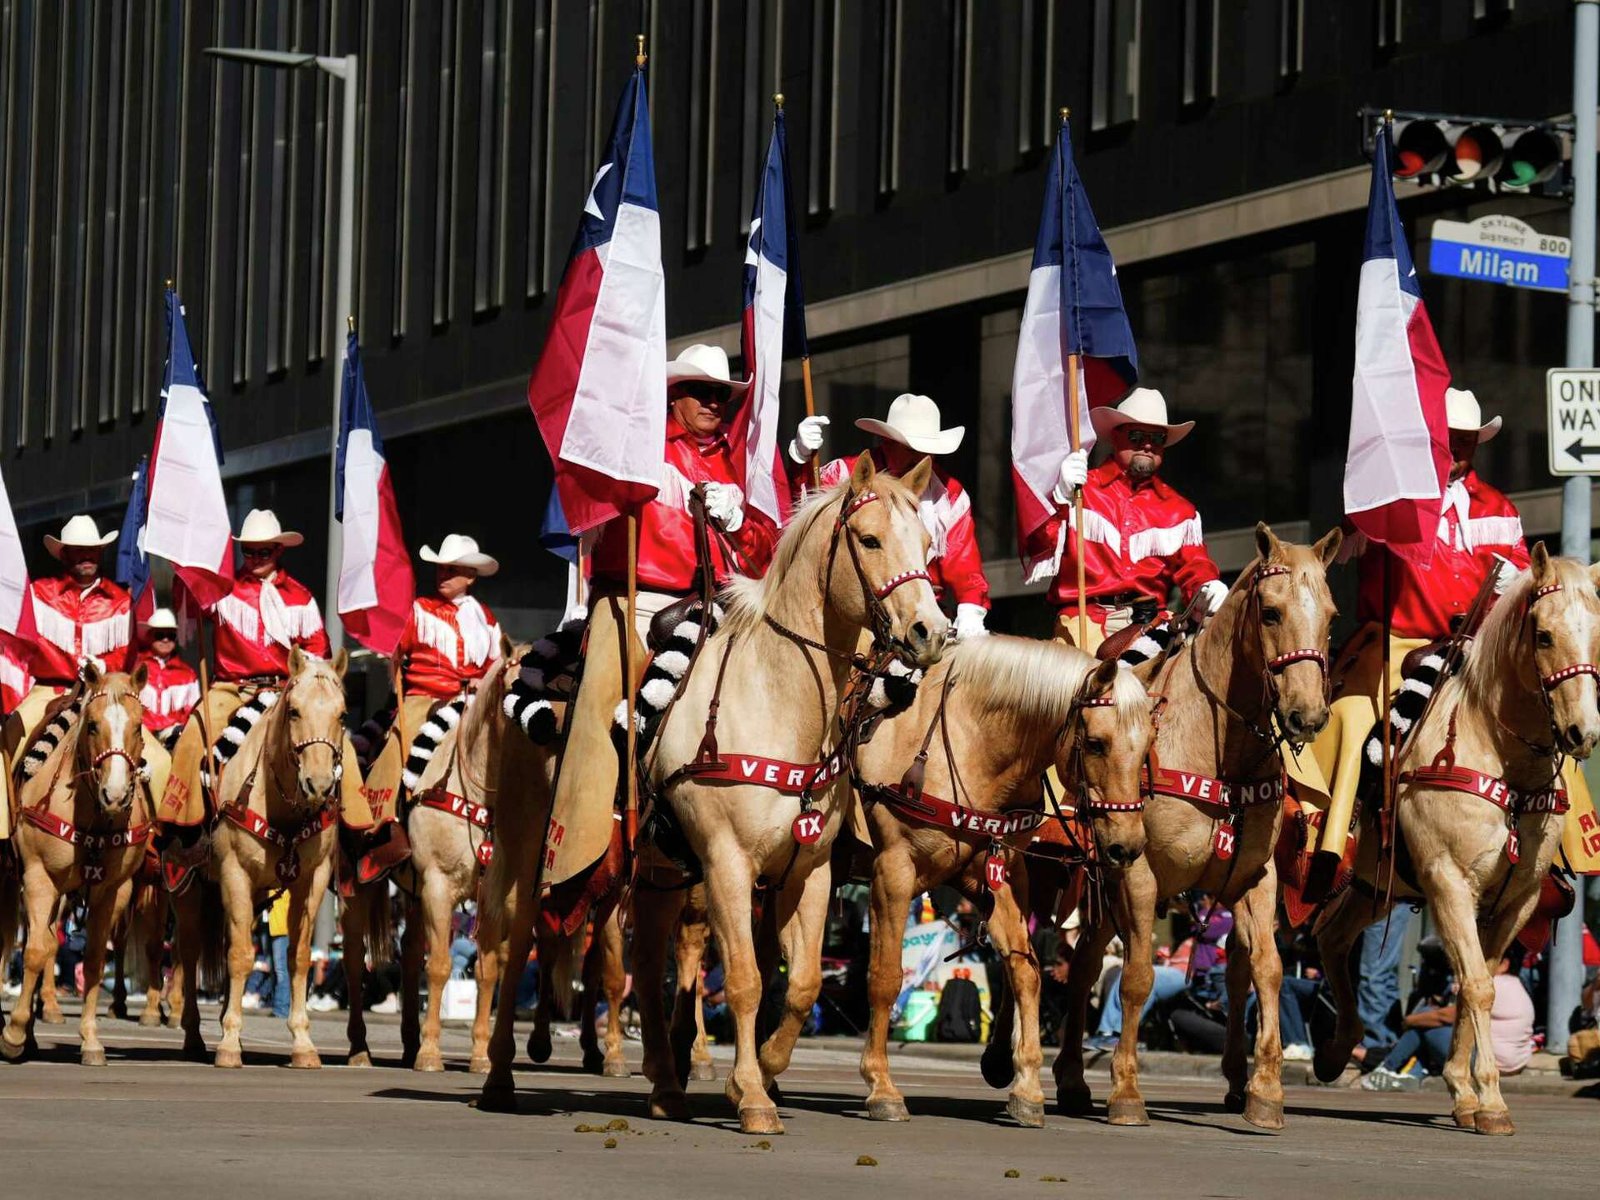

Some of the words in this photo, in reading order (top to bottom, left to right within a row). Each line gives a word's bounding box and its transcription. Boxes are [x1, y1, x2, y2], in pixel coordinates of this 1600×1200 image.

[1479, 231, 1526, 247] DISTRICT
[1539, 238, 1567, 254] 800
[1460, 248, 1539, 283] Milam
[1560, 380, 1600, 402] ON
[1559, 408, 1600, 431] WA
[798, 815, 821, 837] TX
[1217, 830, 1235, 853] TX
[83, 865, 103, 881] TX
[988, 863, 1003, 882] TX
